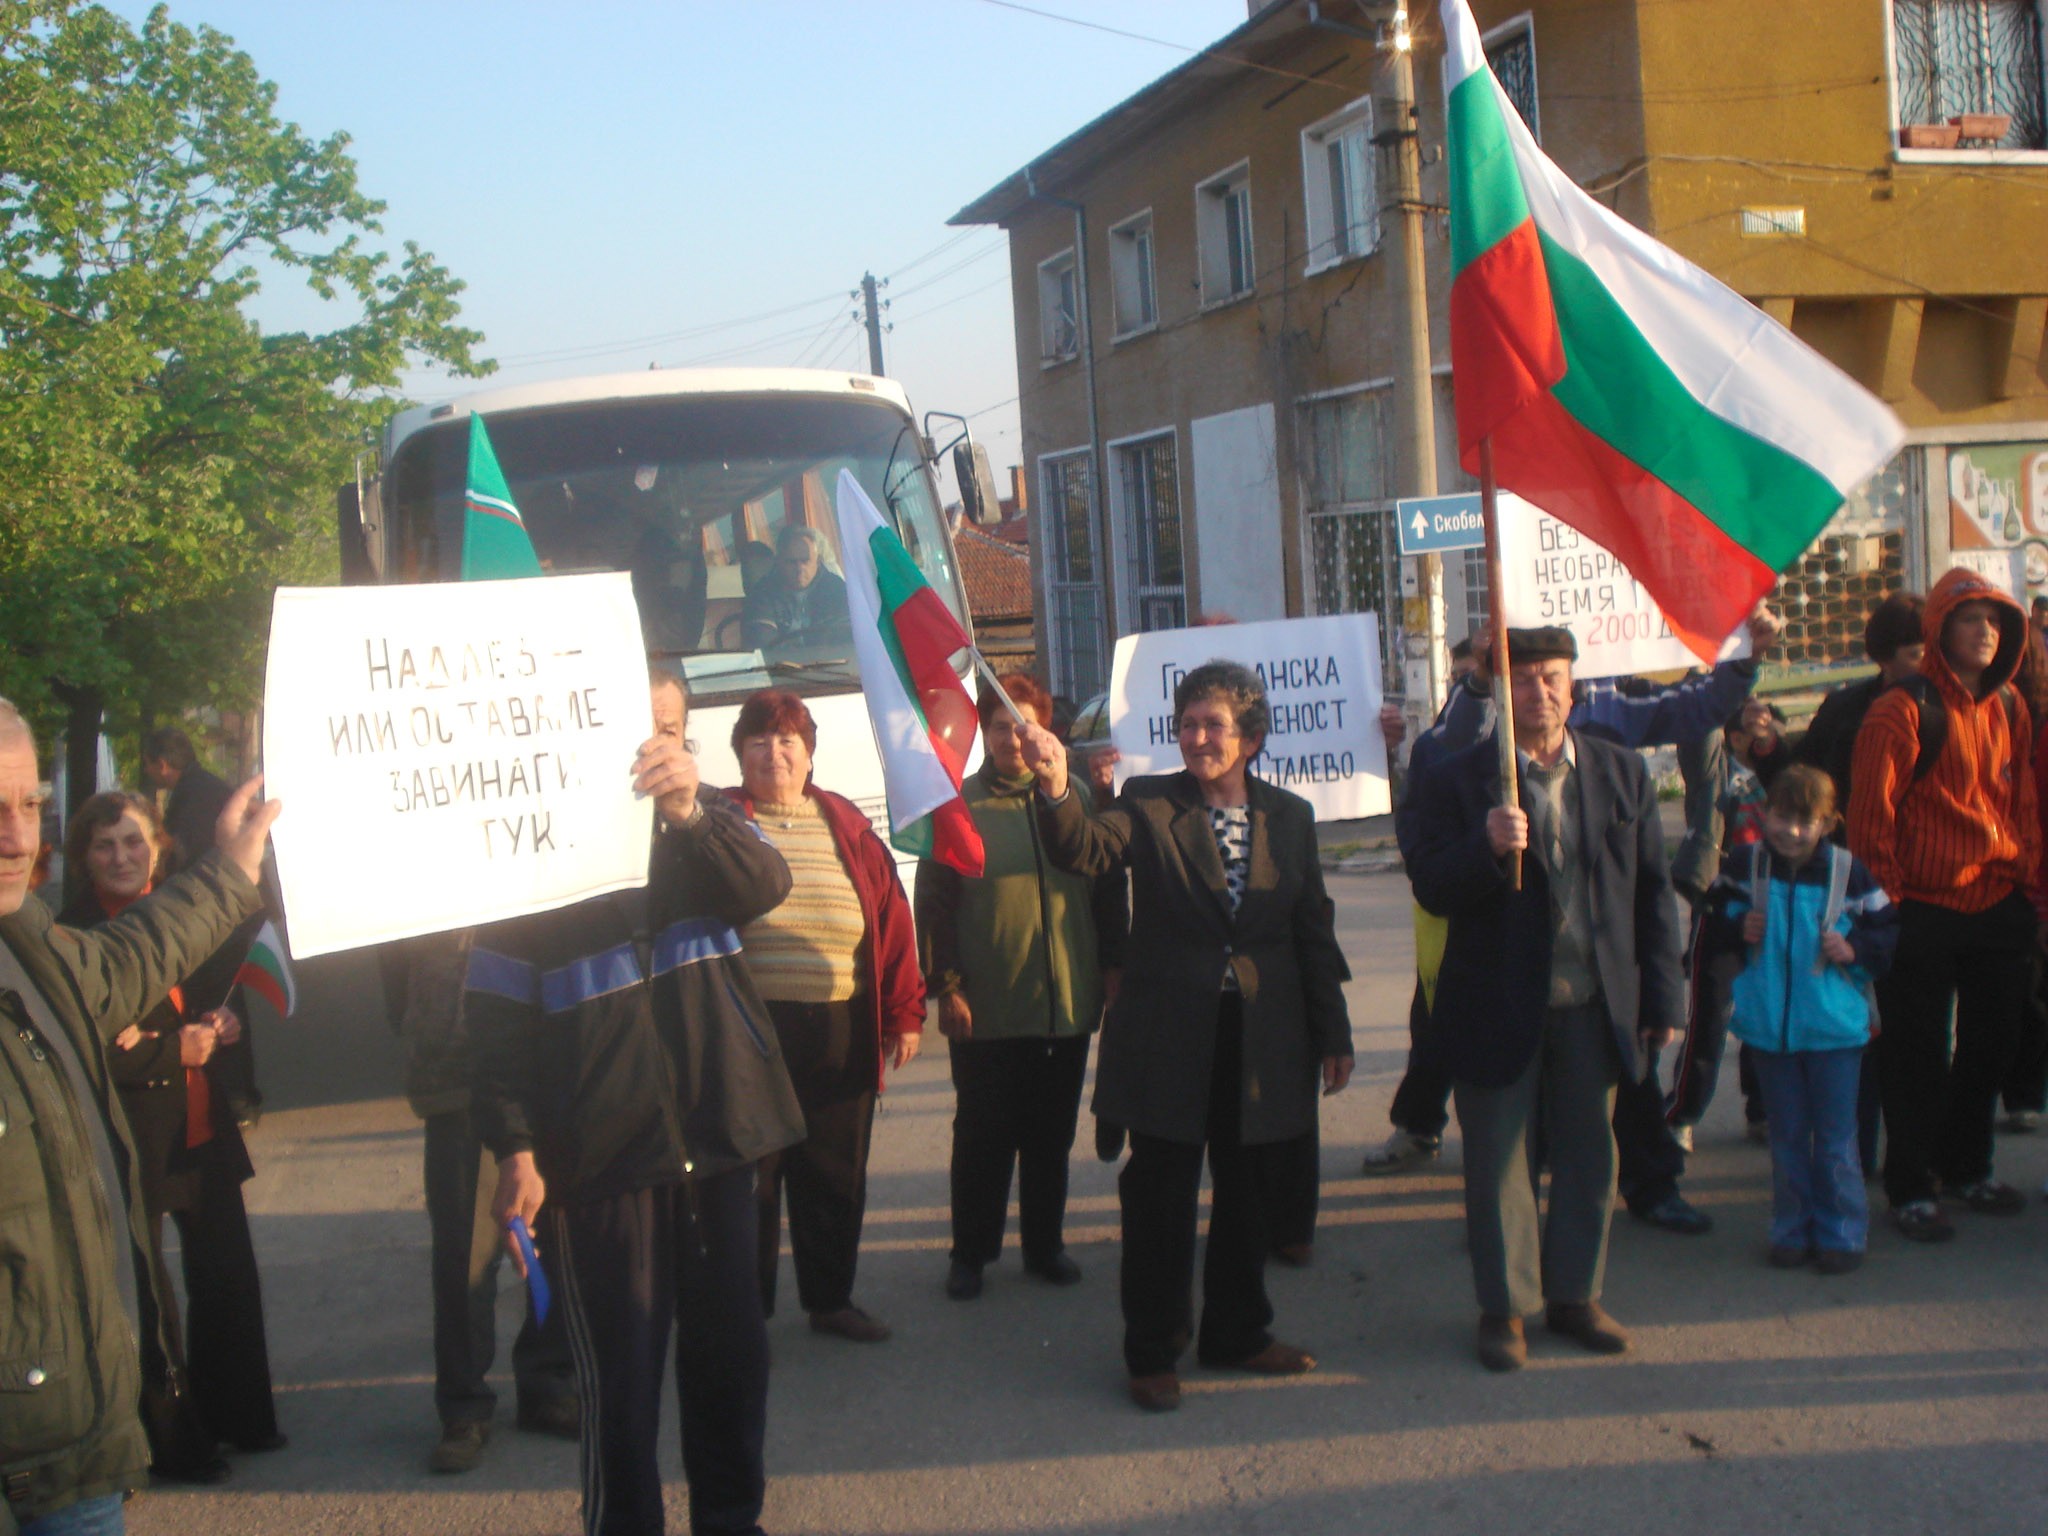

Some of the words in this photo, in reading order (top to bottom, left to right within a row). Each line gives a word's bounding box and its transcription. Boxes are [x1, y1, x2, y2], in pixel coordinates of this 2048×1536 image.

[1434, 509, 1485, 534] Скобел
[1539, 518, 1580, 552] БЕЗ
[1535, 553, 1624, 585] НЕОБРА
[1539, 585, 1616, 618] ЗЕМЯ
[1588, 612, 1651, 645] 2000
[367, 638, 538, 692] НАДЛЕЗ
[329, 711, 398, 757] ИЛИ
[390, 753, 582, 812] ЗАВИНАГИ
[1257, 750, 1355, 787] СТАЛЕВО
